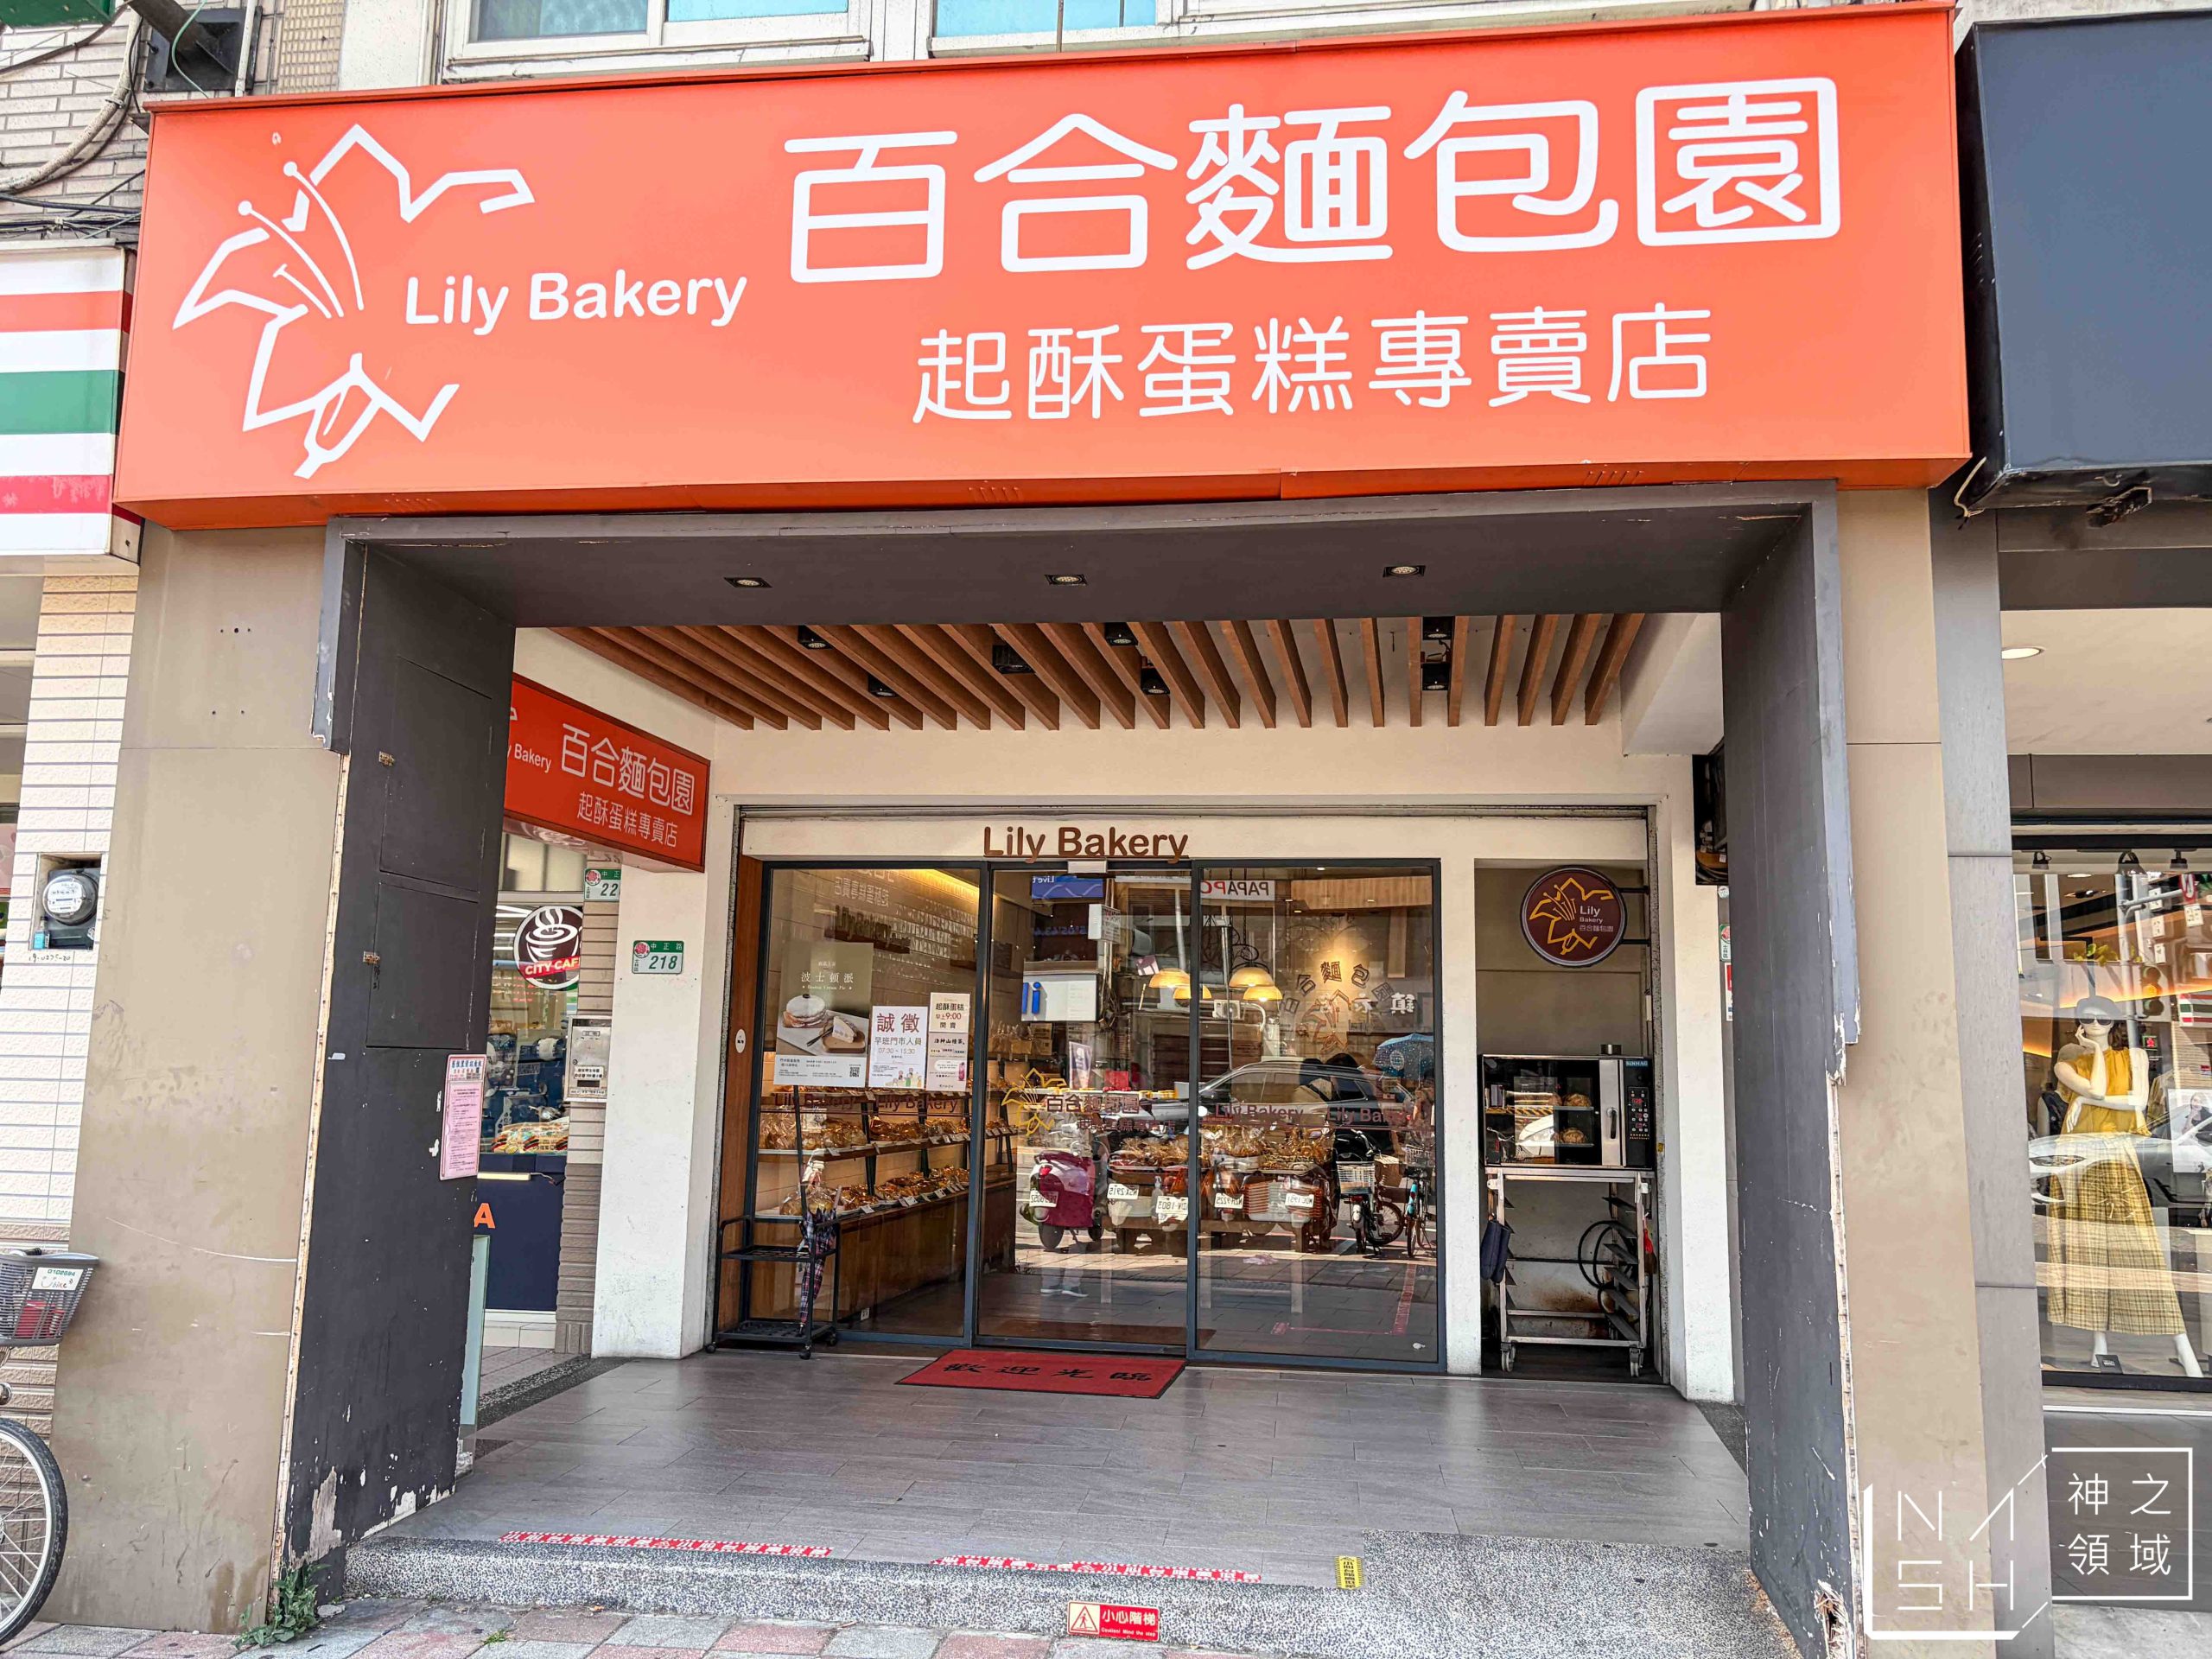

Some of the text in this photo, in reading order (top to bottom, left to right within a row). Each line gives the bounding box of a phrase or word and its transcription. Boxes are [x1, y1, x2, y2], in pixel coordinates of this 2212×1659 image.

[785, 77, 1840, 283] 百合麵包園
[406, 269, 747, 335] Lily Bakery
[913, 302, 1712, 424] 起酥蛋糕專賣店
[514, 743, 552, 773] Bakery
[562, 723, 695, 816] 百合麵包園
[577, 791, 678, 848] 起酥蛋糕專賣店
[984, 826, 1189, 863] Lily Bakery
[601, 882, 621, 897] 22
[1580, 906, 1600, 917] Lily
[525, 957, 581, 975] CITY CAF
[649, 955, 678, 969] 218
[877, 1013, 920, 1033] 誠徵
[874, 1037, 922, 1046] 早班門市人員
[1102, 1609, 1156, 1626] 小心階梯
